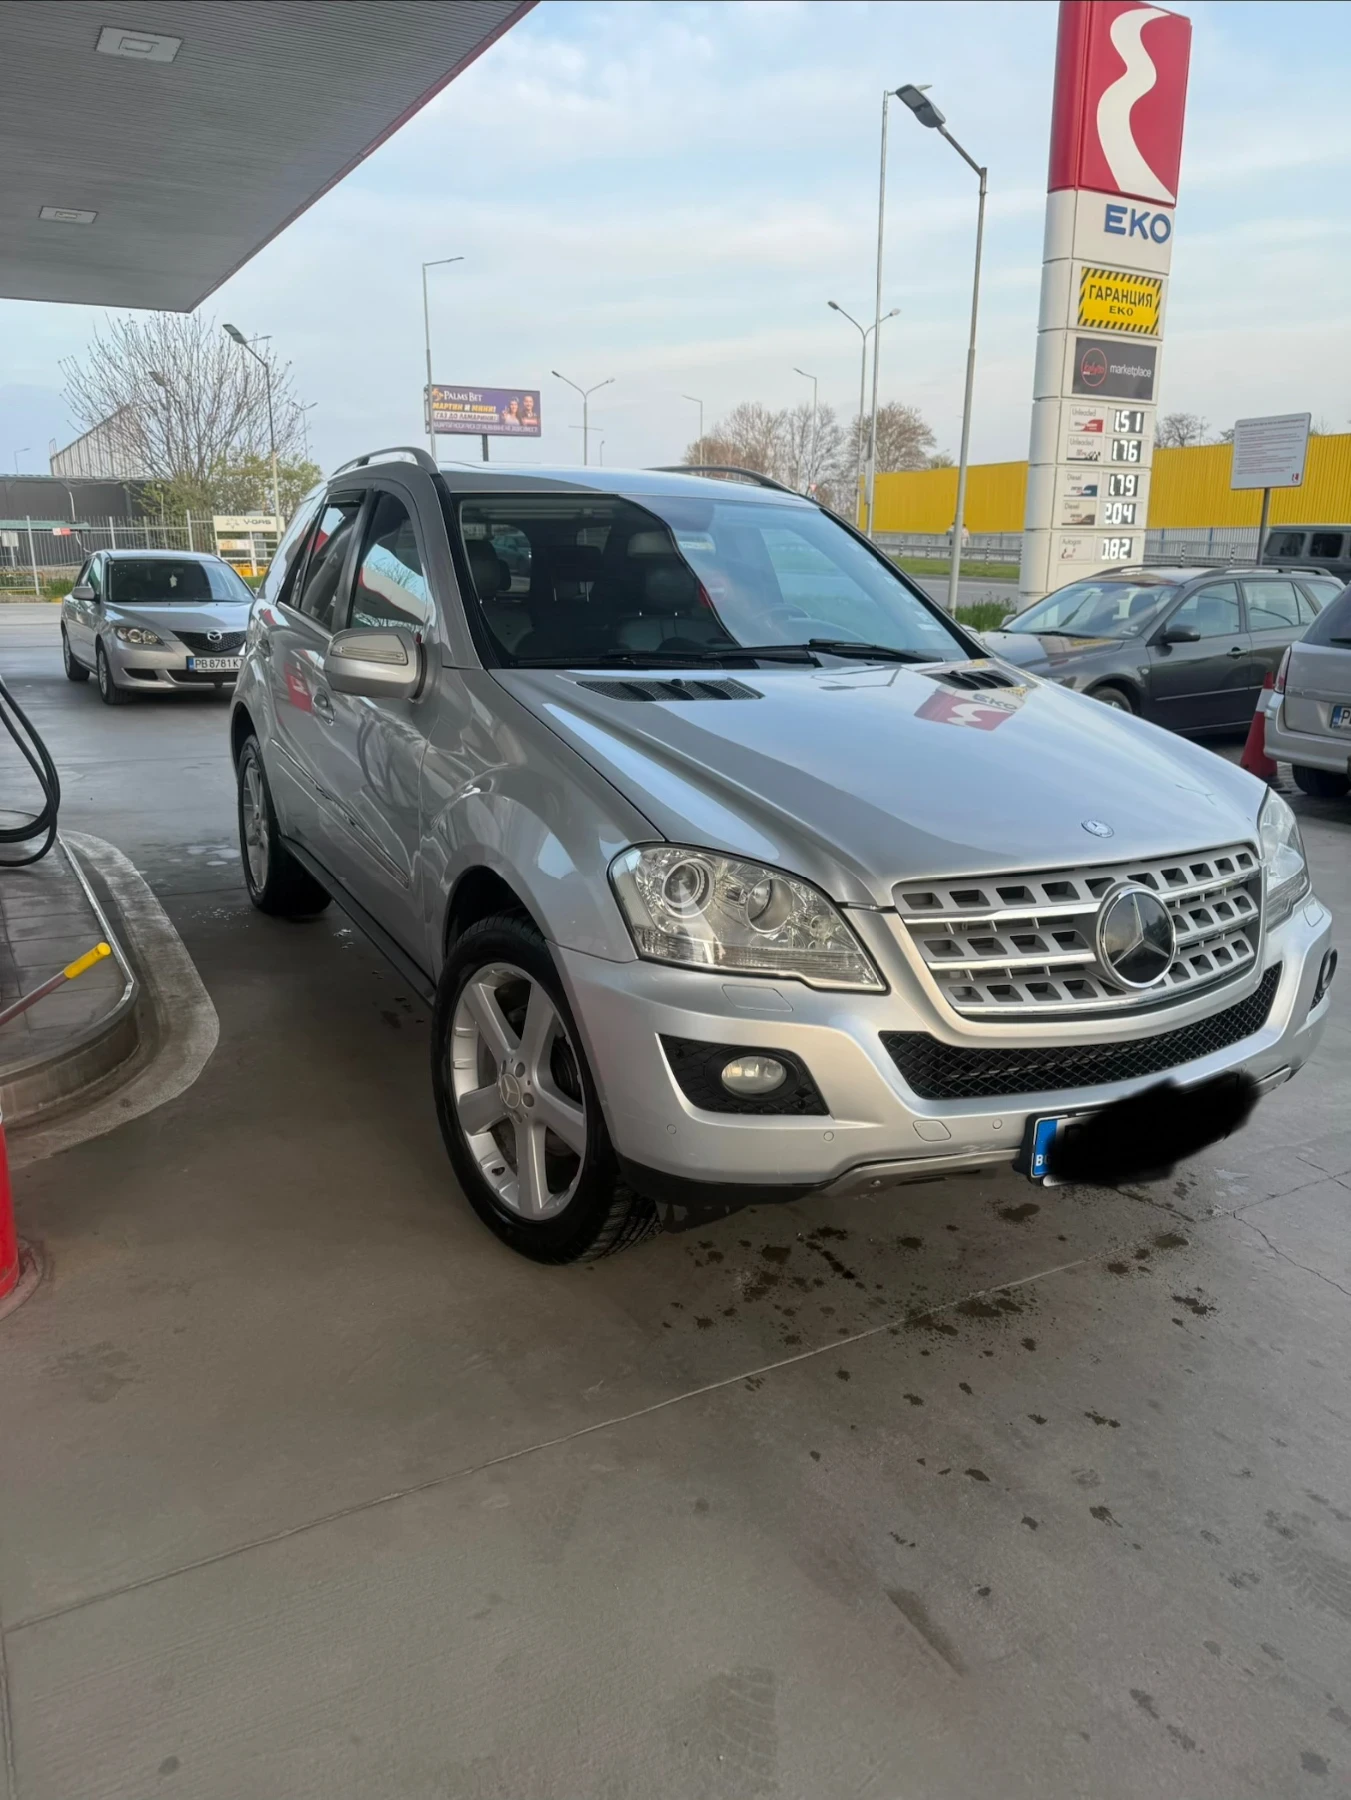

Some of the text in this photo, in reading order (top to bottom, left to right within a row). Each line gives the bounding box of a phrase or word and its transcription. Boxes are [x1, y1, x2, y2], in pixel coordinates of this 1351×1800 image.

[1104, 203, 1171, 244] EKO
[1089, 284, 1153, 308] ГАРАНЦИЯ
[1109, 305, 1134, 317] EKO
[1110, 364, 1152, 378] marketplace
[195, 659, 208, 669] PB
[210, 659, 231, 669] 8781
